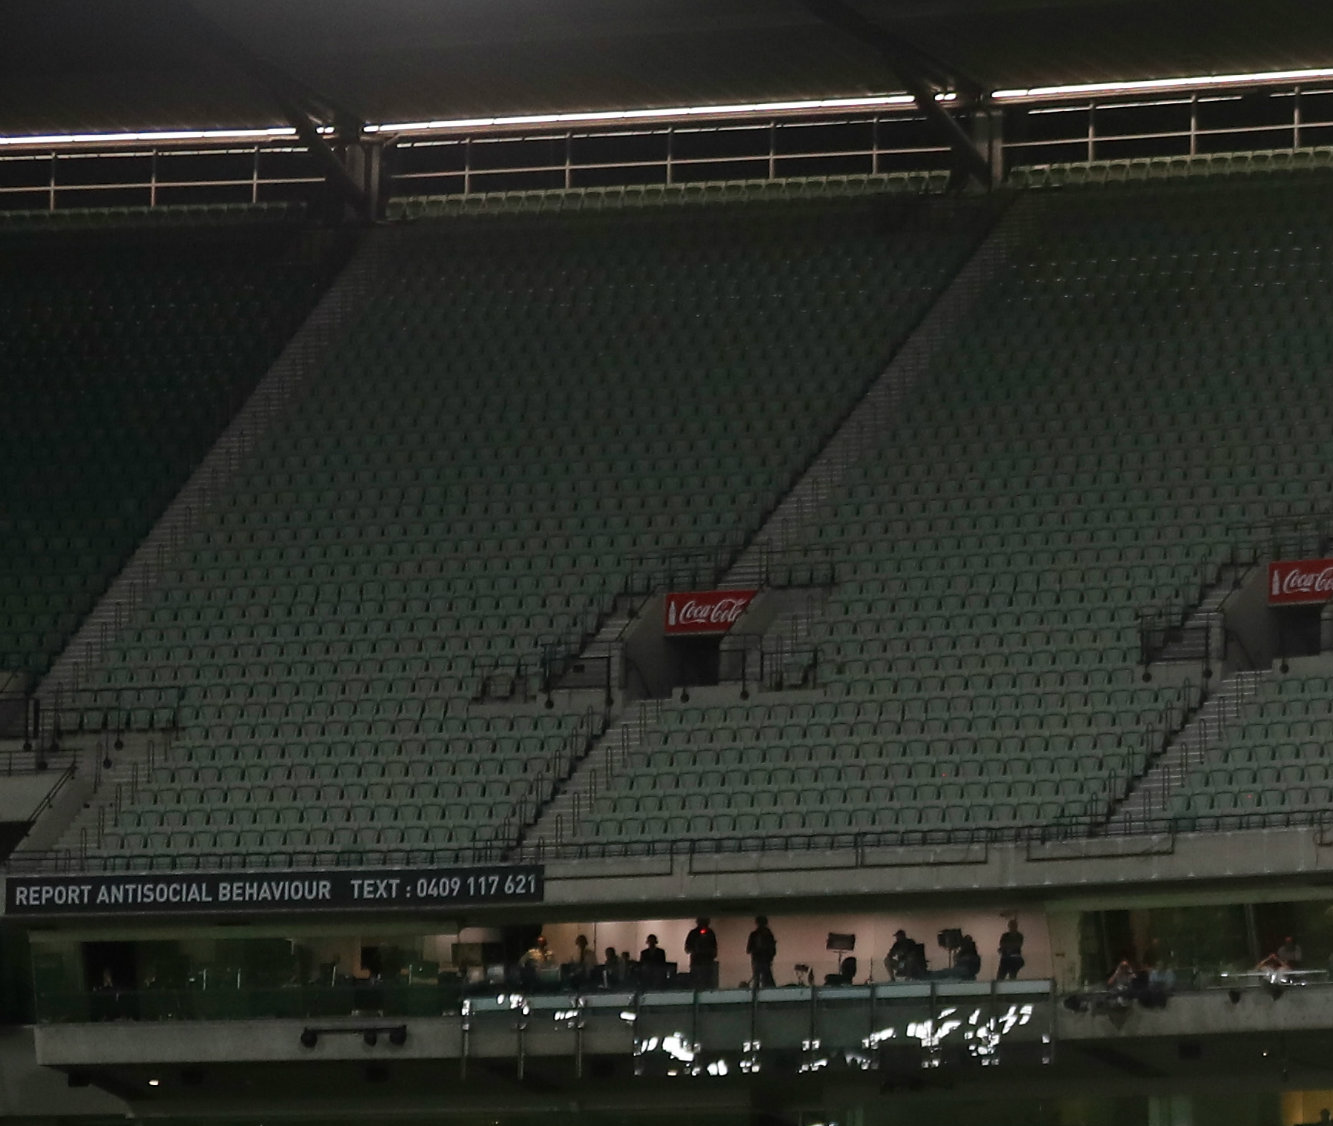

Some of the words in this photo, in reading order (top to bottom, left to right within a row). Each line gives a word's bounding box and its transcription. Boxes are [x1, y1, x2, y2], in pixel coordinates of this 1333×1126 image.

[15, 884, 91, 906] REPORT
[97, 882, 213, 904] ANTISOCIAL
[218, 880, 331, 902] BEHAVIOUR
[351, 878, 402, 899] TEXT
[416, 876, 461, 898] 0409
[466, 874, 498, 896] 117
[503, 873, 536, 895] 621
